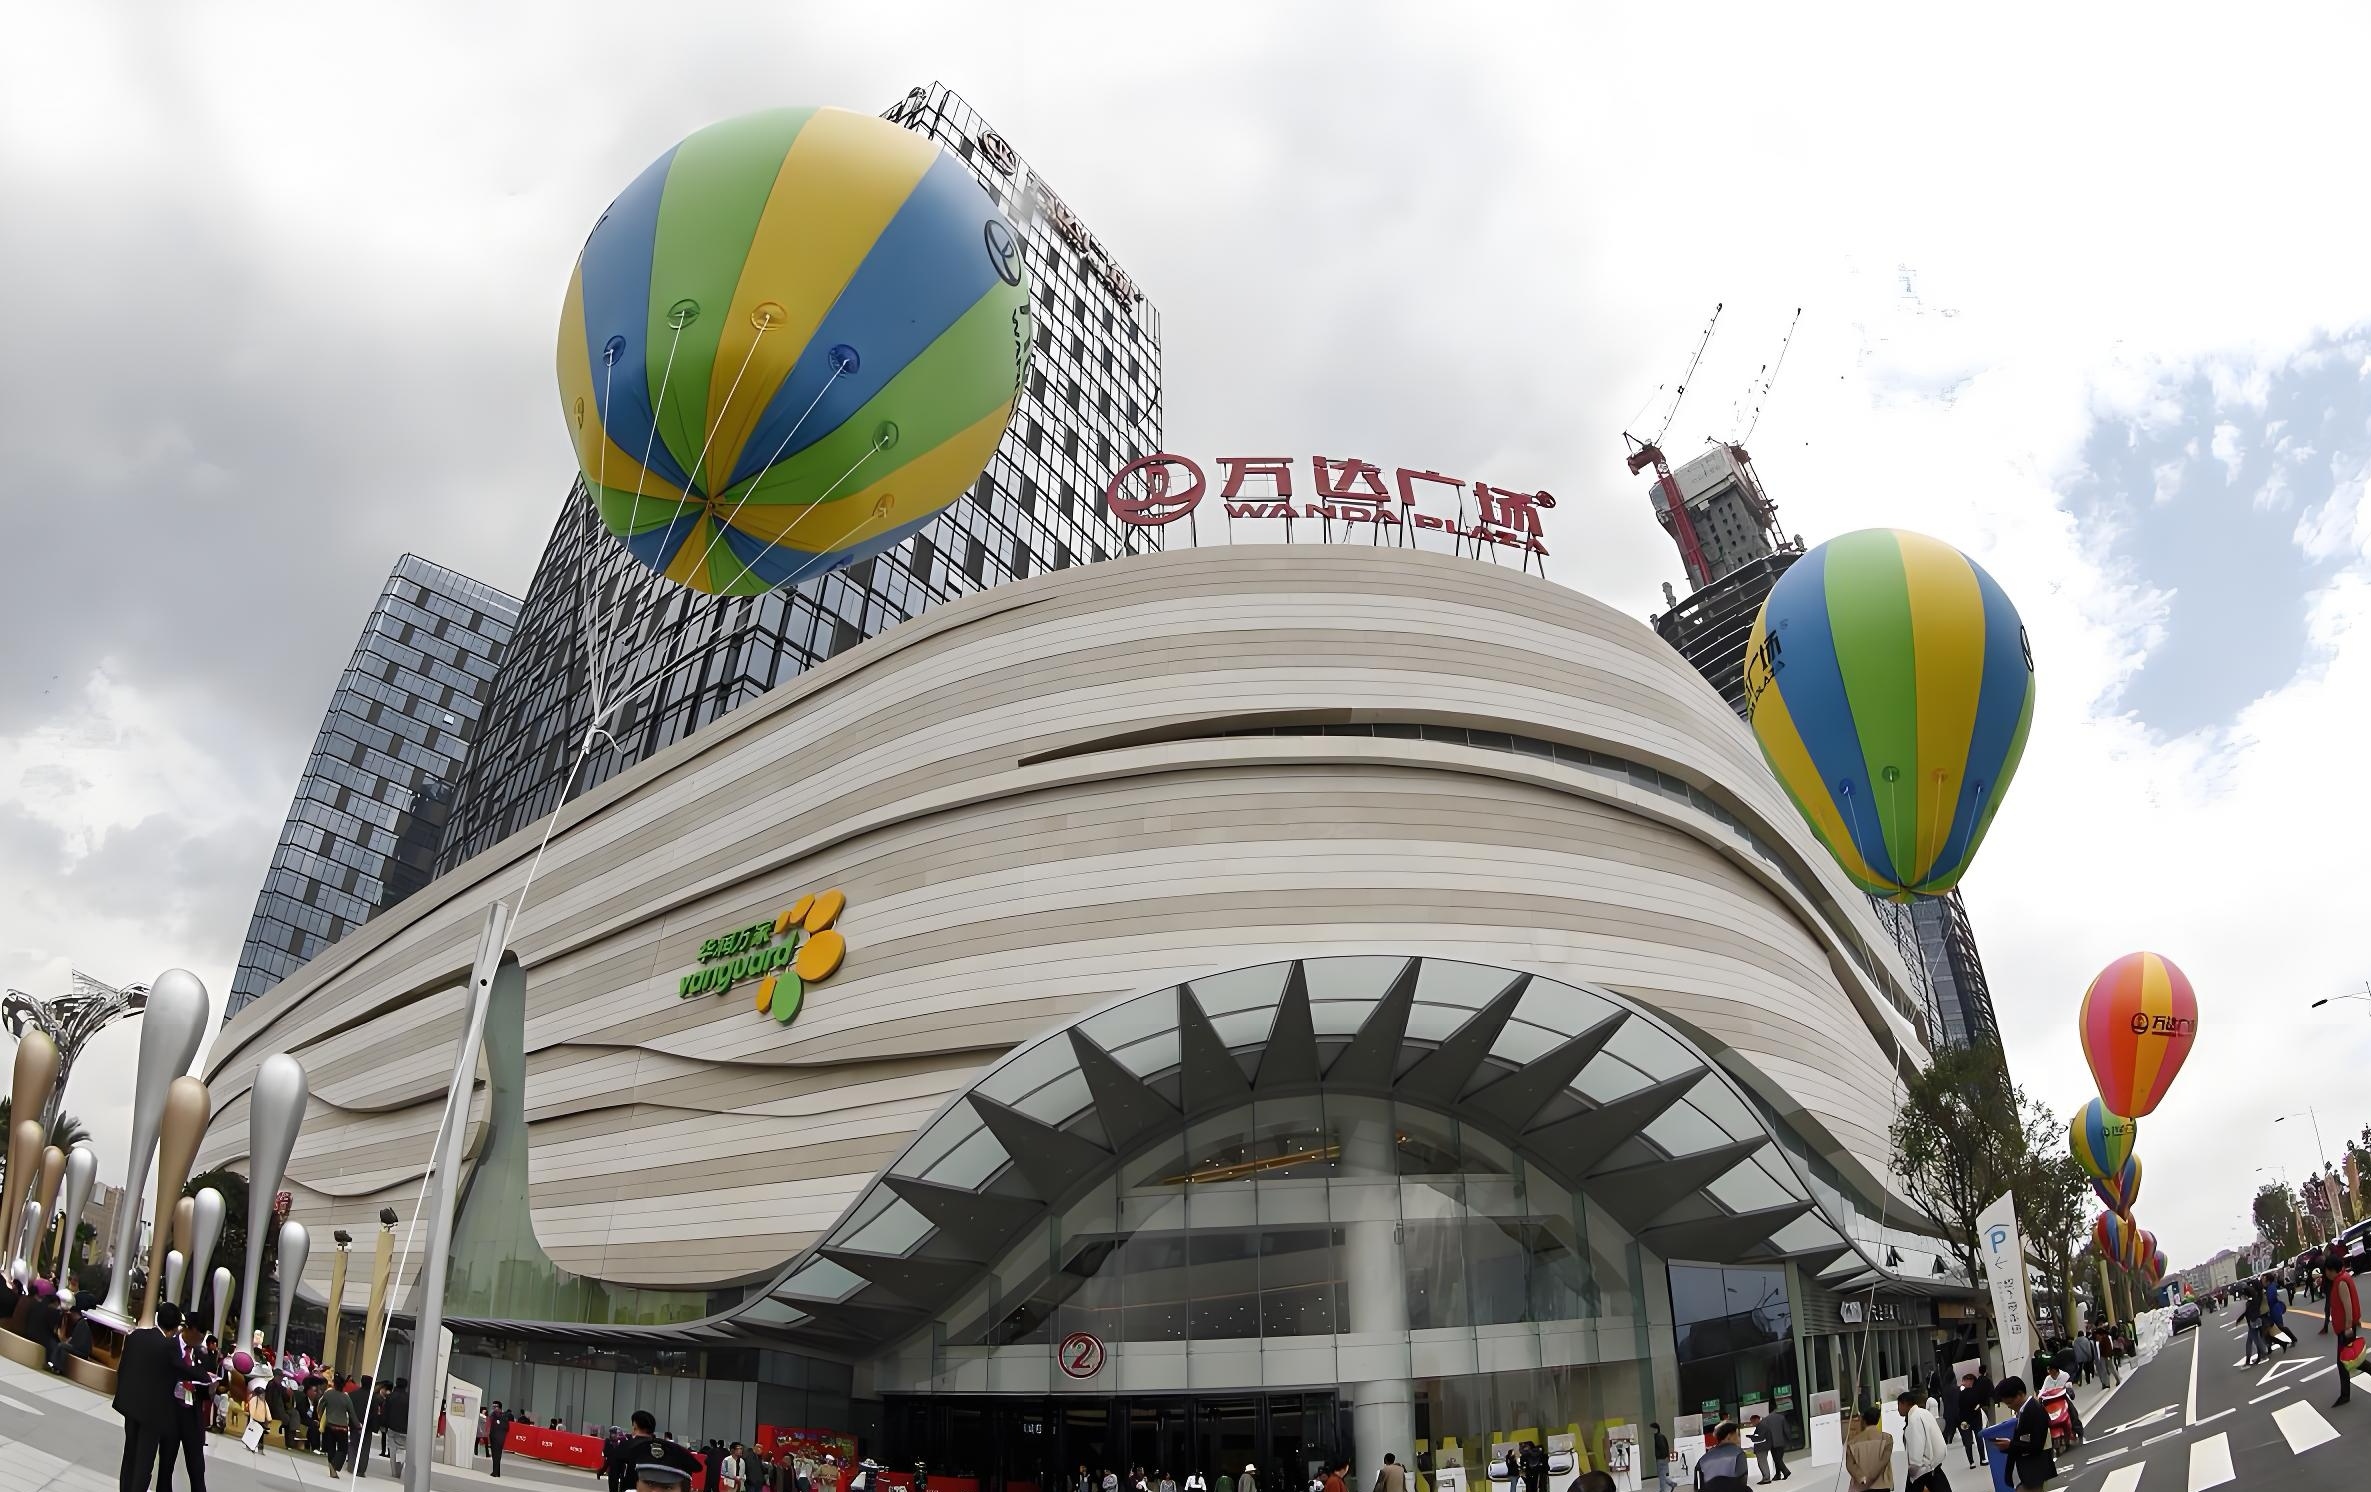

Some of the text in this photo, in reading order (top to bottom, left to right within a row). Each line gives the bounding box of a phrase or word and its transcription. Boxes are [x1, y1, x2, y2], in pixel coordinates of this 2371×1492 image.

[1216, 456, 1544, 537] 万达广场
[1224, 503, 1550, 557] WANDA PLAZA
[679, 928, 800, 999] vanguard
[1990, 1230, 2006, 1254] P
[1070, 1336, 1092, 1369] 2
